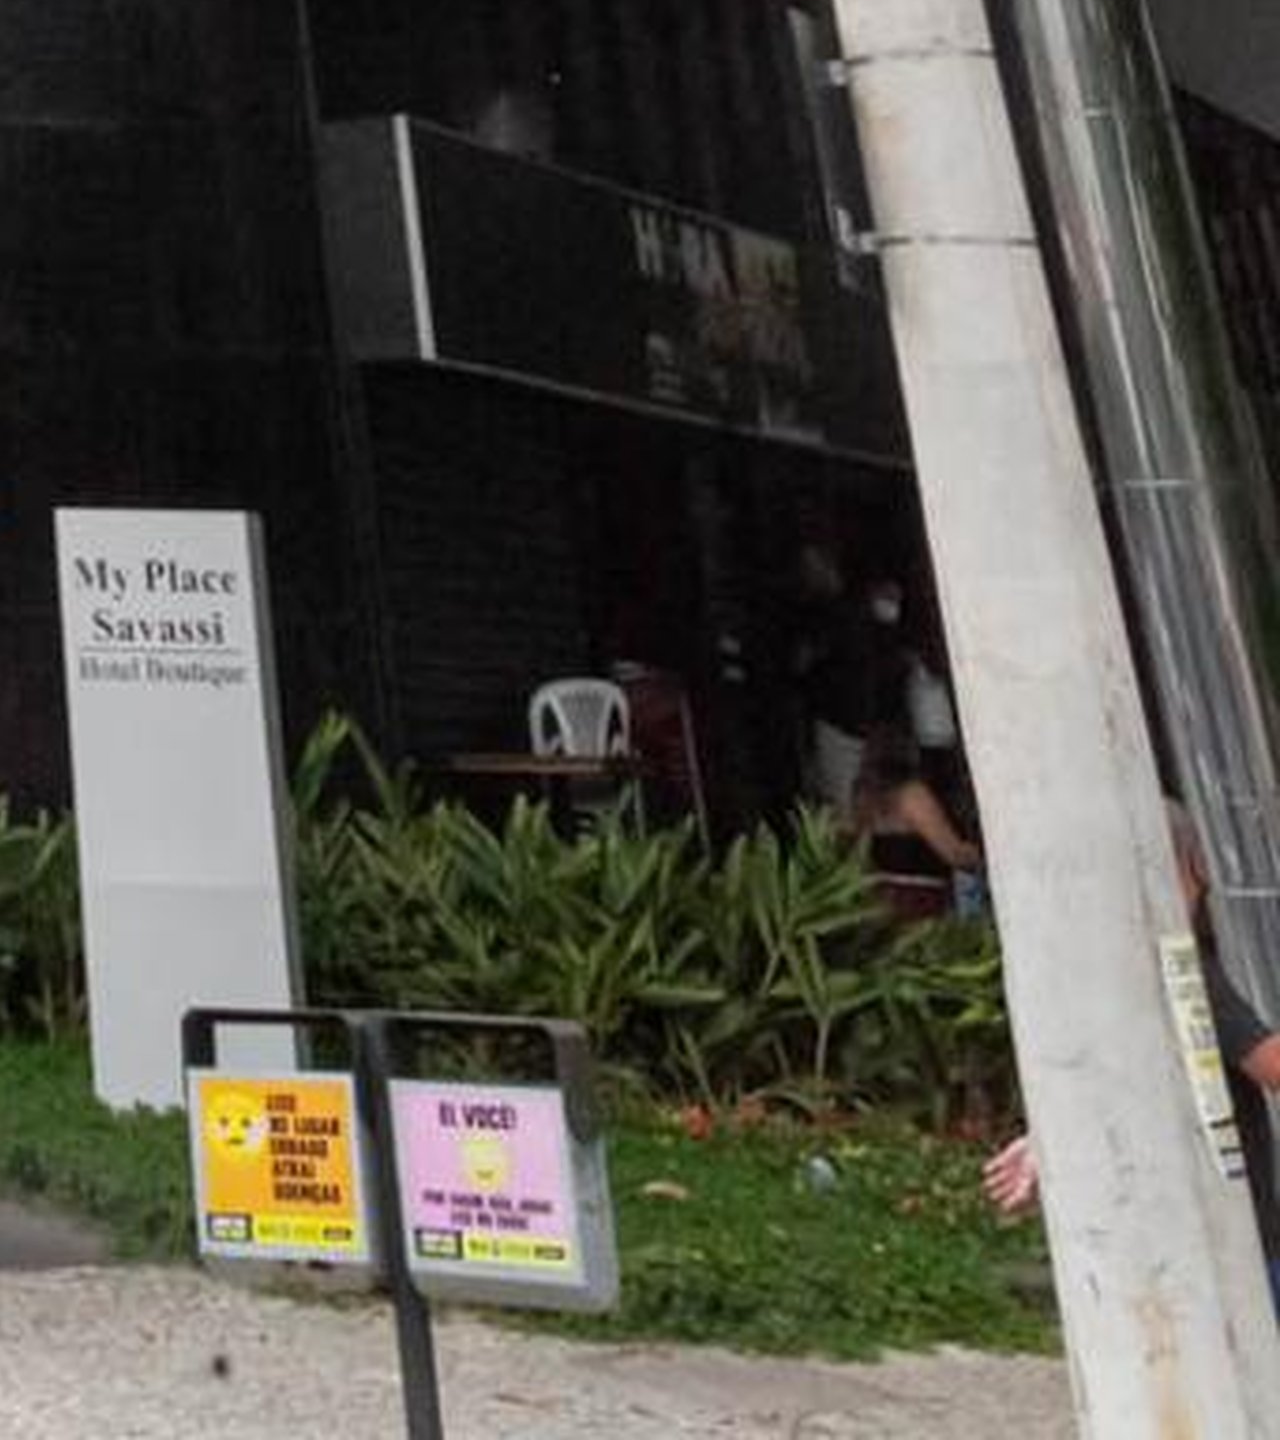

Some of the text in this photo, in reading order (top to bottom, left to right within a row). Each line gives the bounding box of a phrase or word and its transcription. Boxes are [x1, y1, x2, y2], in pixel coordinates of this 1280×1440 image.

[75, 557, 237, 602] My Place
[92, 608, 225, 645] Savassi
